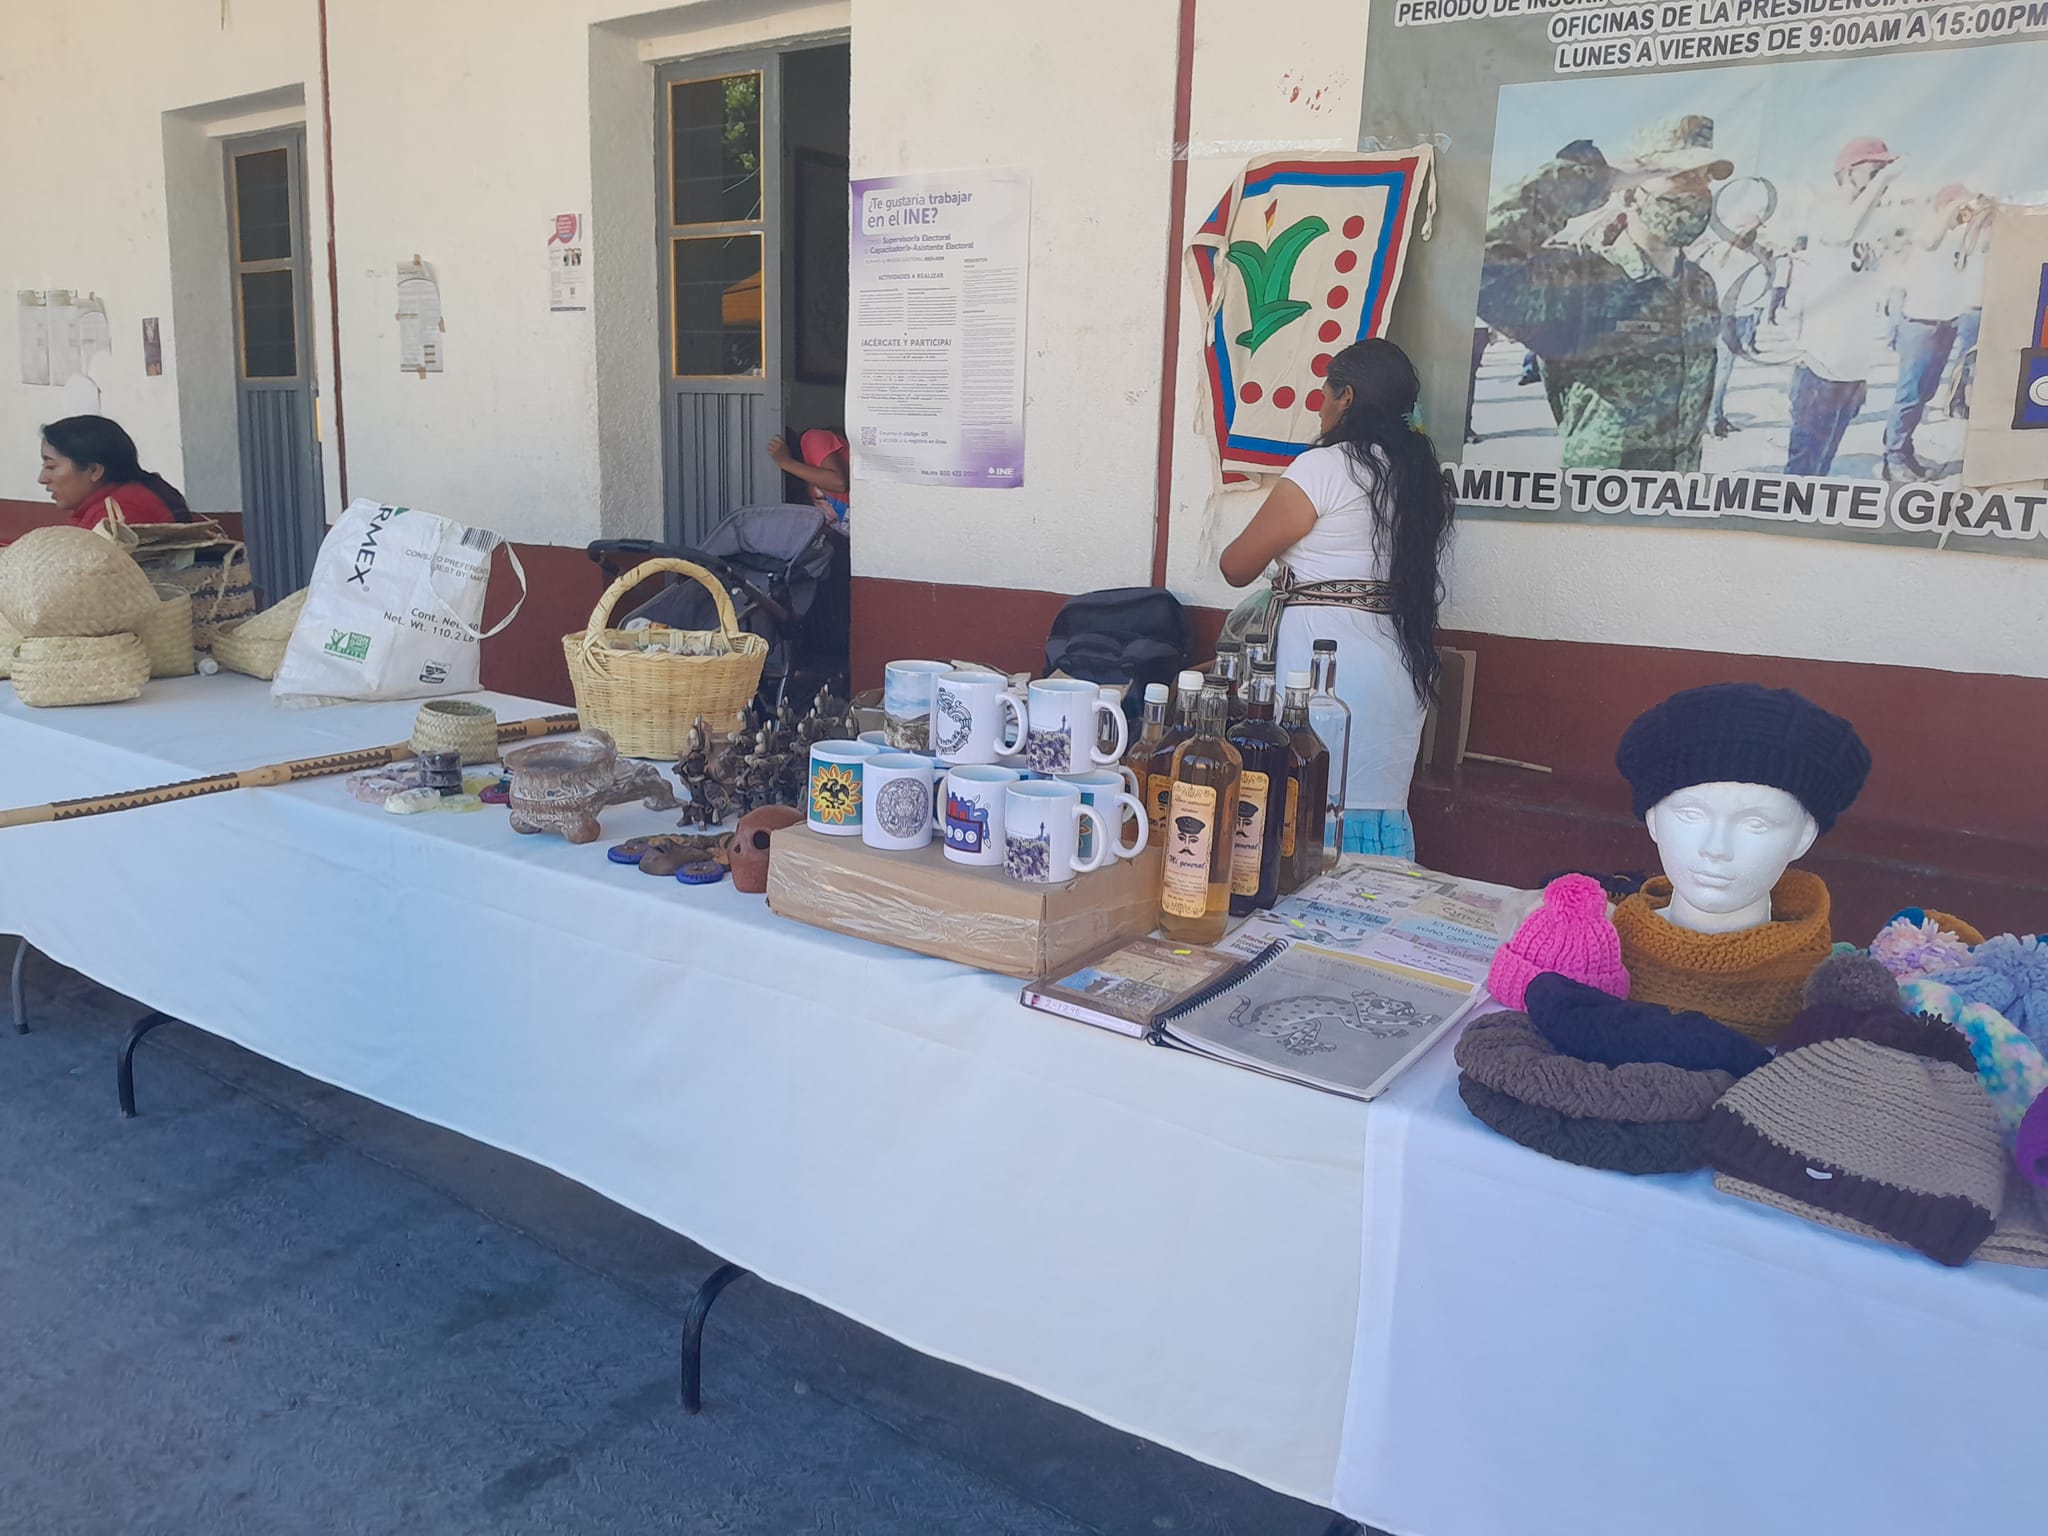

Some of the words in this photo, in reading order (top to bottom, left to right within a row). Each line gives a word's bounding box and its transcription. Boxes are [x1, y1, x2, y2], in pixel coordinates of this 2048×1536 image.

[1398, 0, 1488, 22] PERIODO
[1493, 0, 1520, 13] DE
[1552, 9, 1654, 38] OFICINAS
[1661, 5, 1693, 28] DE
[1700, 1, 1729, 25] LA
[1736, 0, 1908, 21] PRESIDE
[1559, 42, 1631, 68] LUNES
[1637, 40, 1653, 63] A
[1660, 31, 1760, 60] VIERNES
[1768, 26, 1802, 51] DE
[1808, 19, 1902, 48] 9:00AM
[1906, 15, 1926, 39] A
[1936, 2, 2048, 36] 15:00PM
[868, 197, 883, 213] ¿Te
[885, 194, 926, 212] gustaría
[929, 191, 973, 206] trabajar
[867, 214, 885, 228] en
[888, 211, 900, 226] el
[904, 207, 938, 225] INE?
[922, 233, 951, 242] Electoral
[946, 241, 974, 250] Electoral
[861, 338, 901, 347] ¡ACÉRCATE
[902, 338, 909, 347] Y
[910, 338, 952, 347] PARTICIPA!
[1571, 472, 1881, 522] TOTALMENTE
[1898, 488, 2048, 531] GRAT
[346, 504, 393, 585] RMEX
[384, 610, 405, 627] Net.
[410, 618, 427, 633] Wt.
[433, 626, 461, 641] 110.2
[411, 607, 438, 624] Cont.
[1169, 854, 1178, 865] Mi
[1180, 861, 1205, 870] general
